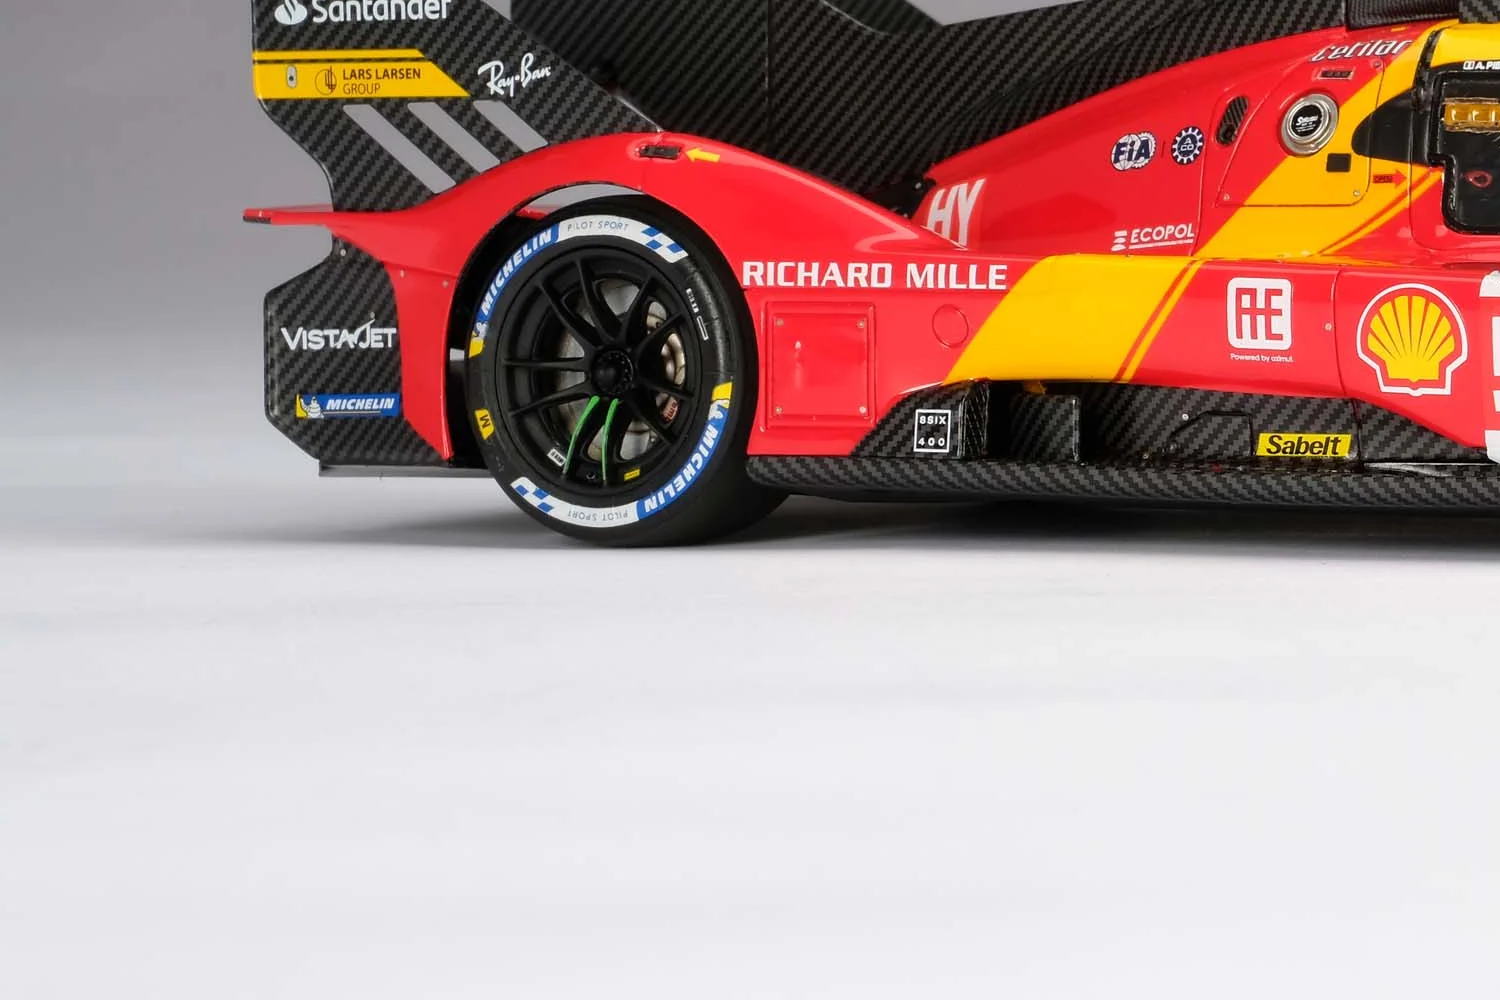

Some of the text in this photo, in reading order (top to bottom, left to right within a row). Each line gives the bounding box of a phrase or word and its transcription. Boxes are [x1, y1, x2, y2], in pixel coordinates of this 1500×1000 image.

[343, 67, 421, 81] LARS LARSEN
[343, 83, 381, 95] GROUP
[927, 177, 987, 247] HY
[567, 221, 629, 232] PILOT SPORT
[1130, 223, 1195, 244] ECOPOL
[480, 229, 552, 315] MICHELIN
[742, 261, 1009, 290] RICHARD MILLE
[325, 397, 396, 411] MICHELIN
[1265, 434, 1342, 456] Sabelt
[644, 425, 720, 513] MICHELIN
[567, 510, 598, 522] SPORT
